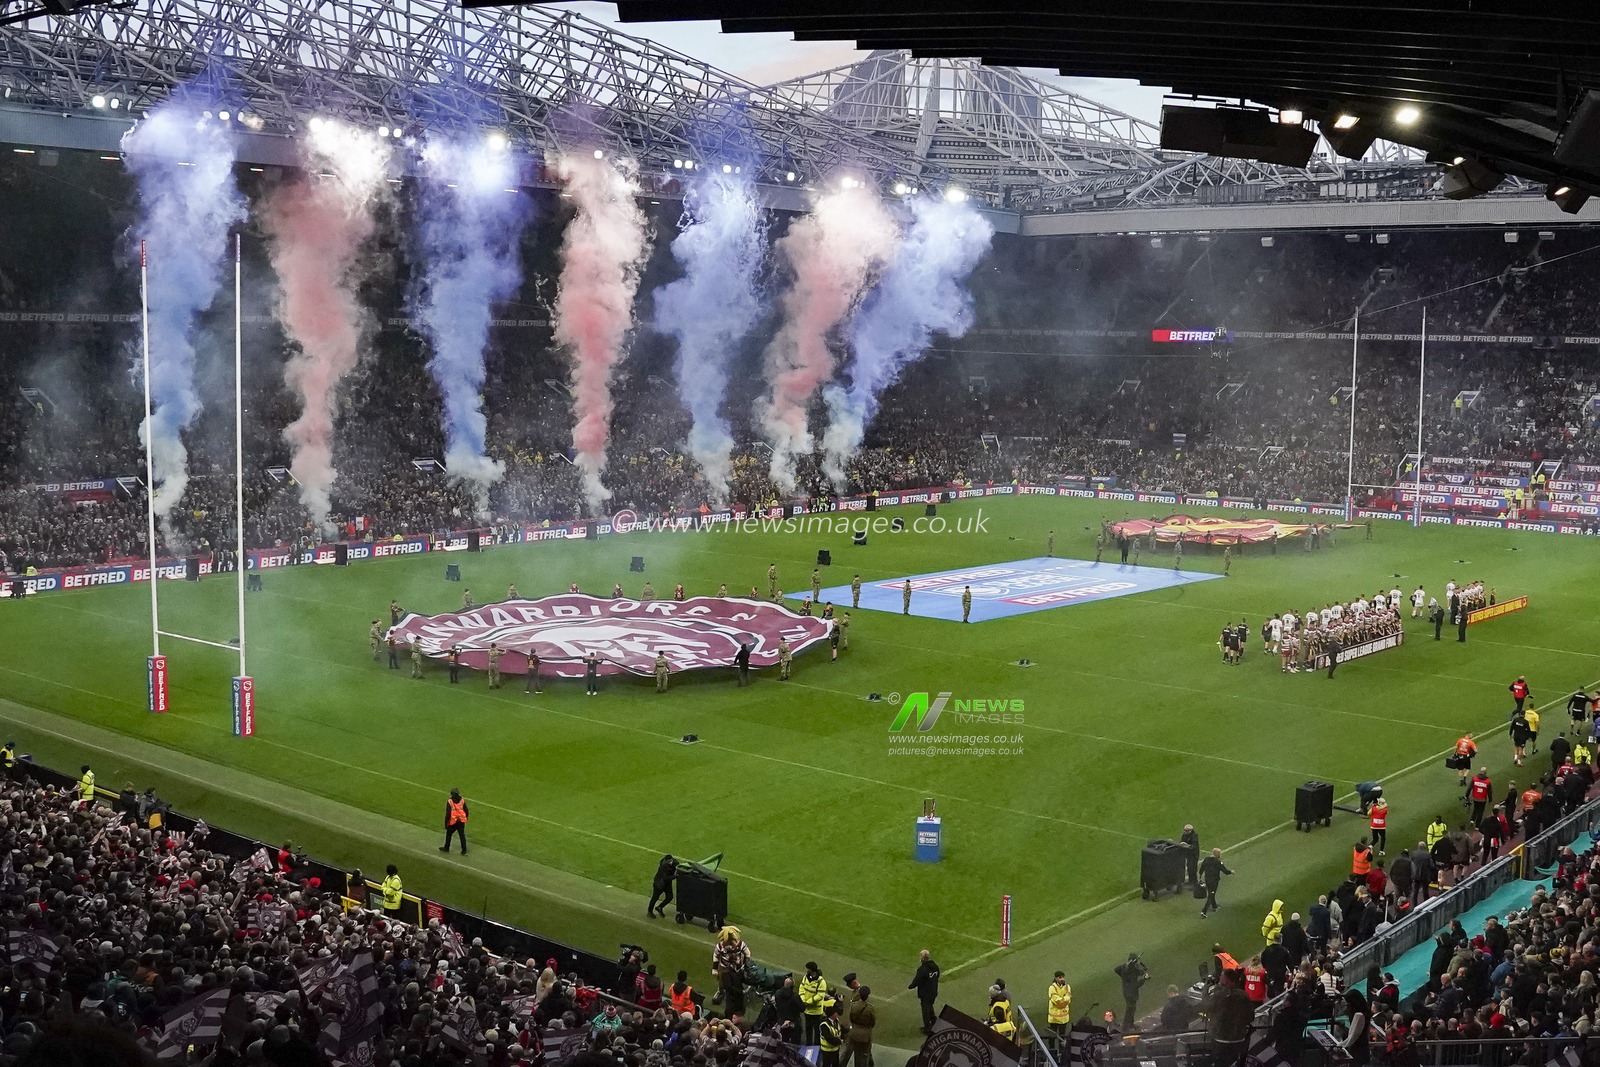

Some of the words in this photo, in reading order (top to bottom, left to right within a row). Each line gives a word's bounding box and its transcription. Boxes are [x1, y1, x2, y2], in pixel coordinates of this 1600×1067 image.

[1169, 331, 1215, 341] BETFRED
[1019, 487, 1055, 495] BETFRED
[1060, 489, 1094, 498] BETFRED
[1098, 491, 1134, 501] BETFRED
[1139, 495, 1175, 504] BETFRED
[1438, 485, 1475, 493] BETFRED
[1455, 498, 1499, 508] BETFRED
[1551, 504, 1598, 514] BETFRED
[64, 571, 126, 587] BETFRED
[375, 543, 422, 557] BETFRED
[527, 529, 567, 542] BETFRED
[875, 497, 899, 507] ETFRED
[959, 489, 983, 498] BETFRED
[986, 486, 1013, 495] BETFRED
[928, 1032, 960, 1050] WIGAN
